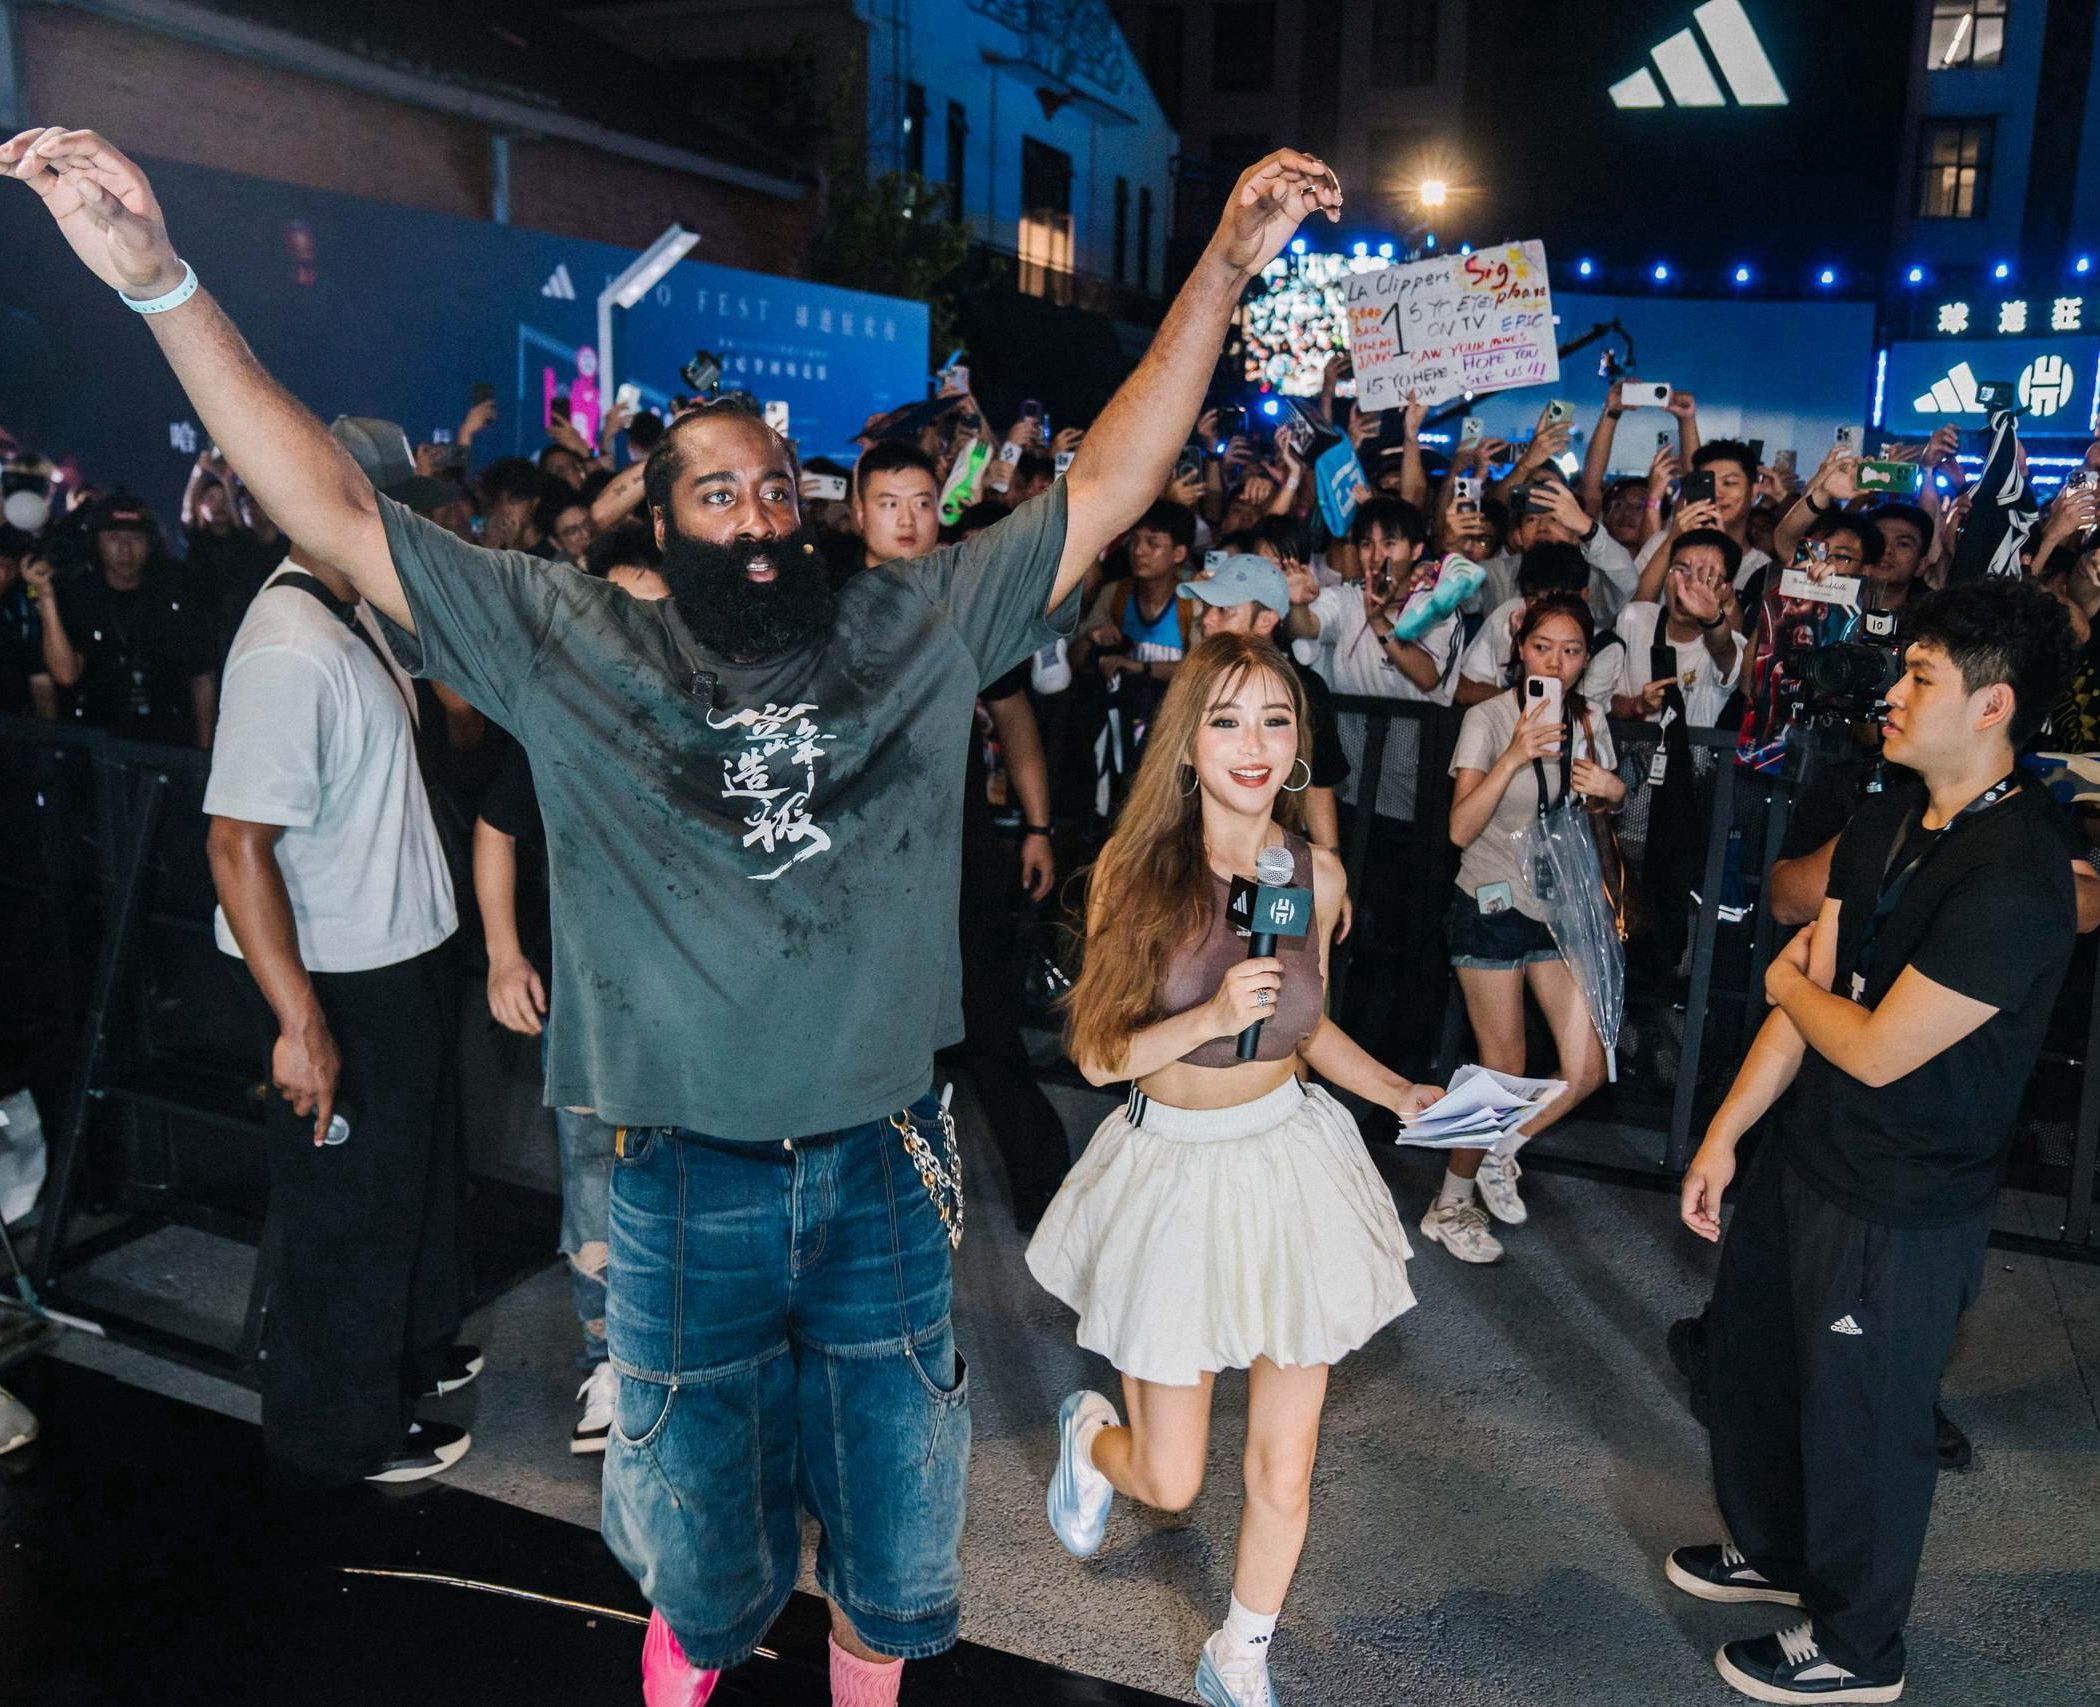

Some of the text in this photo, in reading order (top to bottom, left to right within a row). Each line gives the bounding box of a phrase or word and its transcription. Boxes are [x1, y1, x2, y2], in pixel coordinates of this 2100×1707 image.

[1464, 255, 1508, 290] Sig
[1347, 271, 1450, 302] LA Clippers
[1381, 302, 1409, 357] 1
[1461, 313, 1486, 331] TV
[1450, 341, 1485, 357] YOUR
[1513, 349, 1538, 359] YOU
[1366, 377, 1384, 395] 15
[1872, 620, 1883, 630] 10
[1830, 1324, 1863, 1335] adidas
